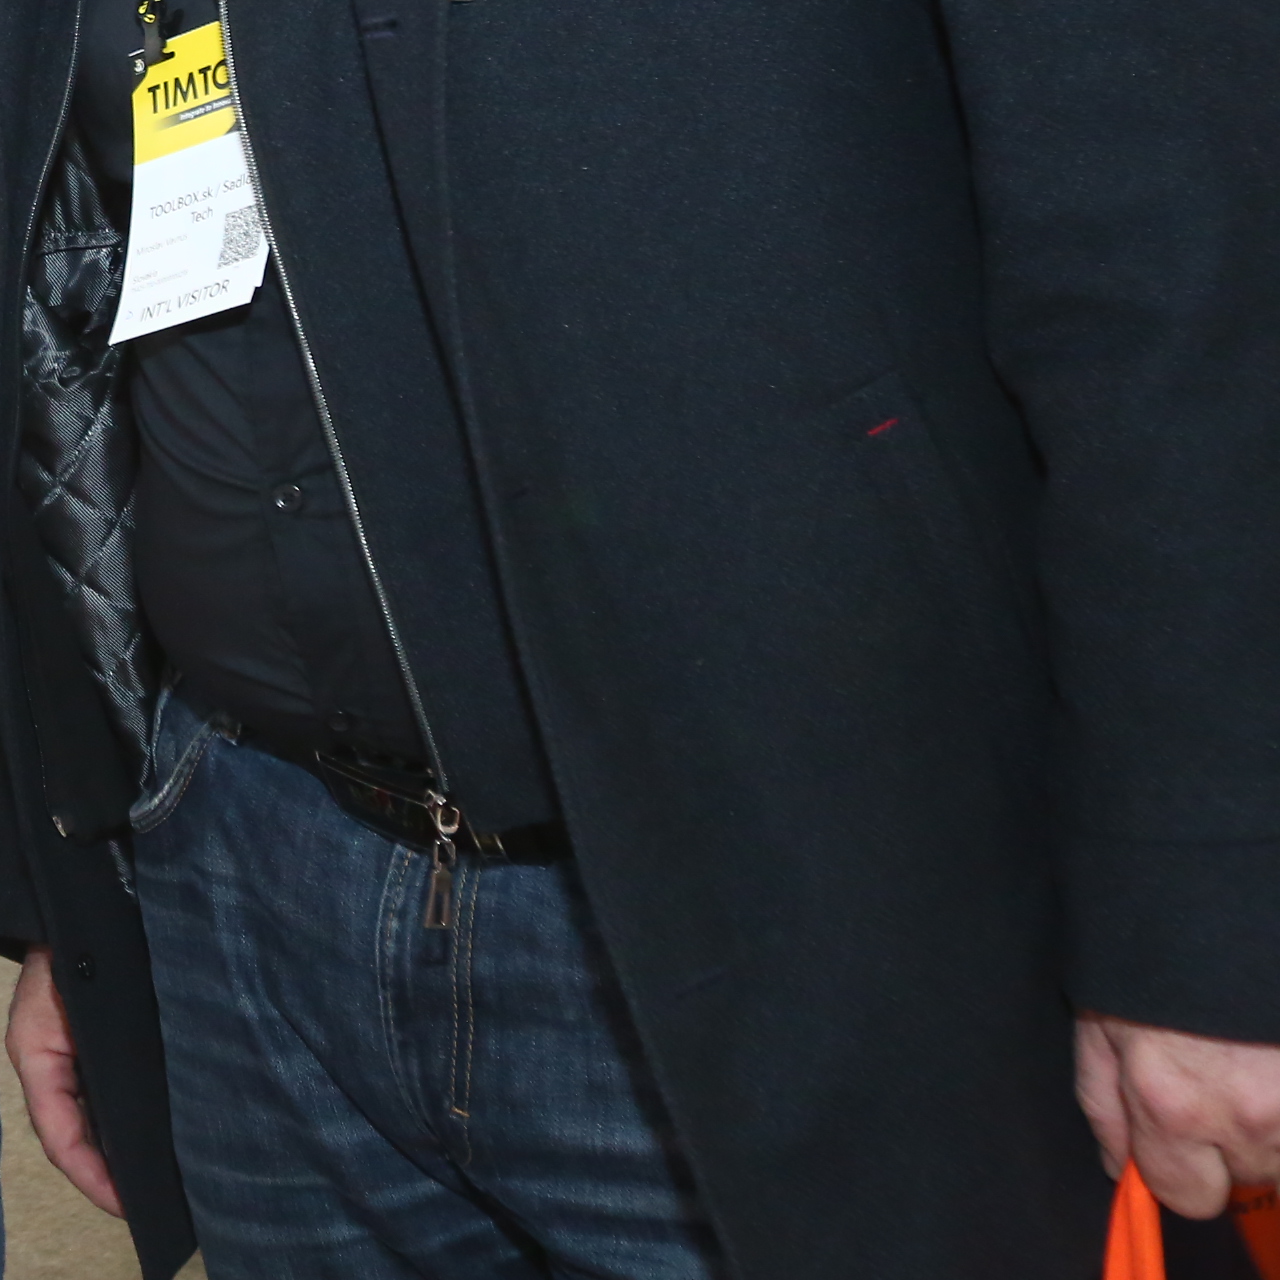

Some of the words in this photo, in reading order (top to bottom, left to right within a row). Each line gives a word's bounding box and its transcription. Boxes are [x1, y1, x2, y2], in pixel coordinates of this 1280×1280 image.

[147, 58, 231, 114] TIMTO
[149, 186, 214, 220] TOOLBOX.sk
[190, 206, 214, 224] Tech
[140, 298, 172, 322] INT'L
[177, 279, 230, 310] VISITOR
